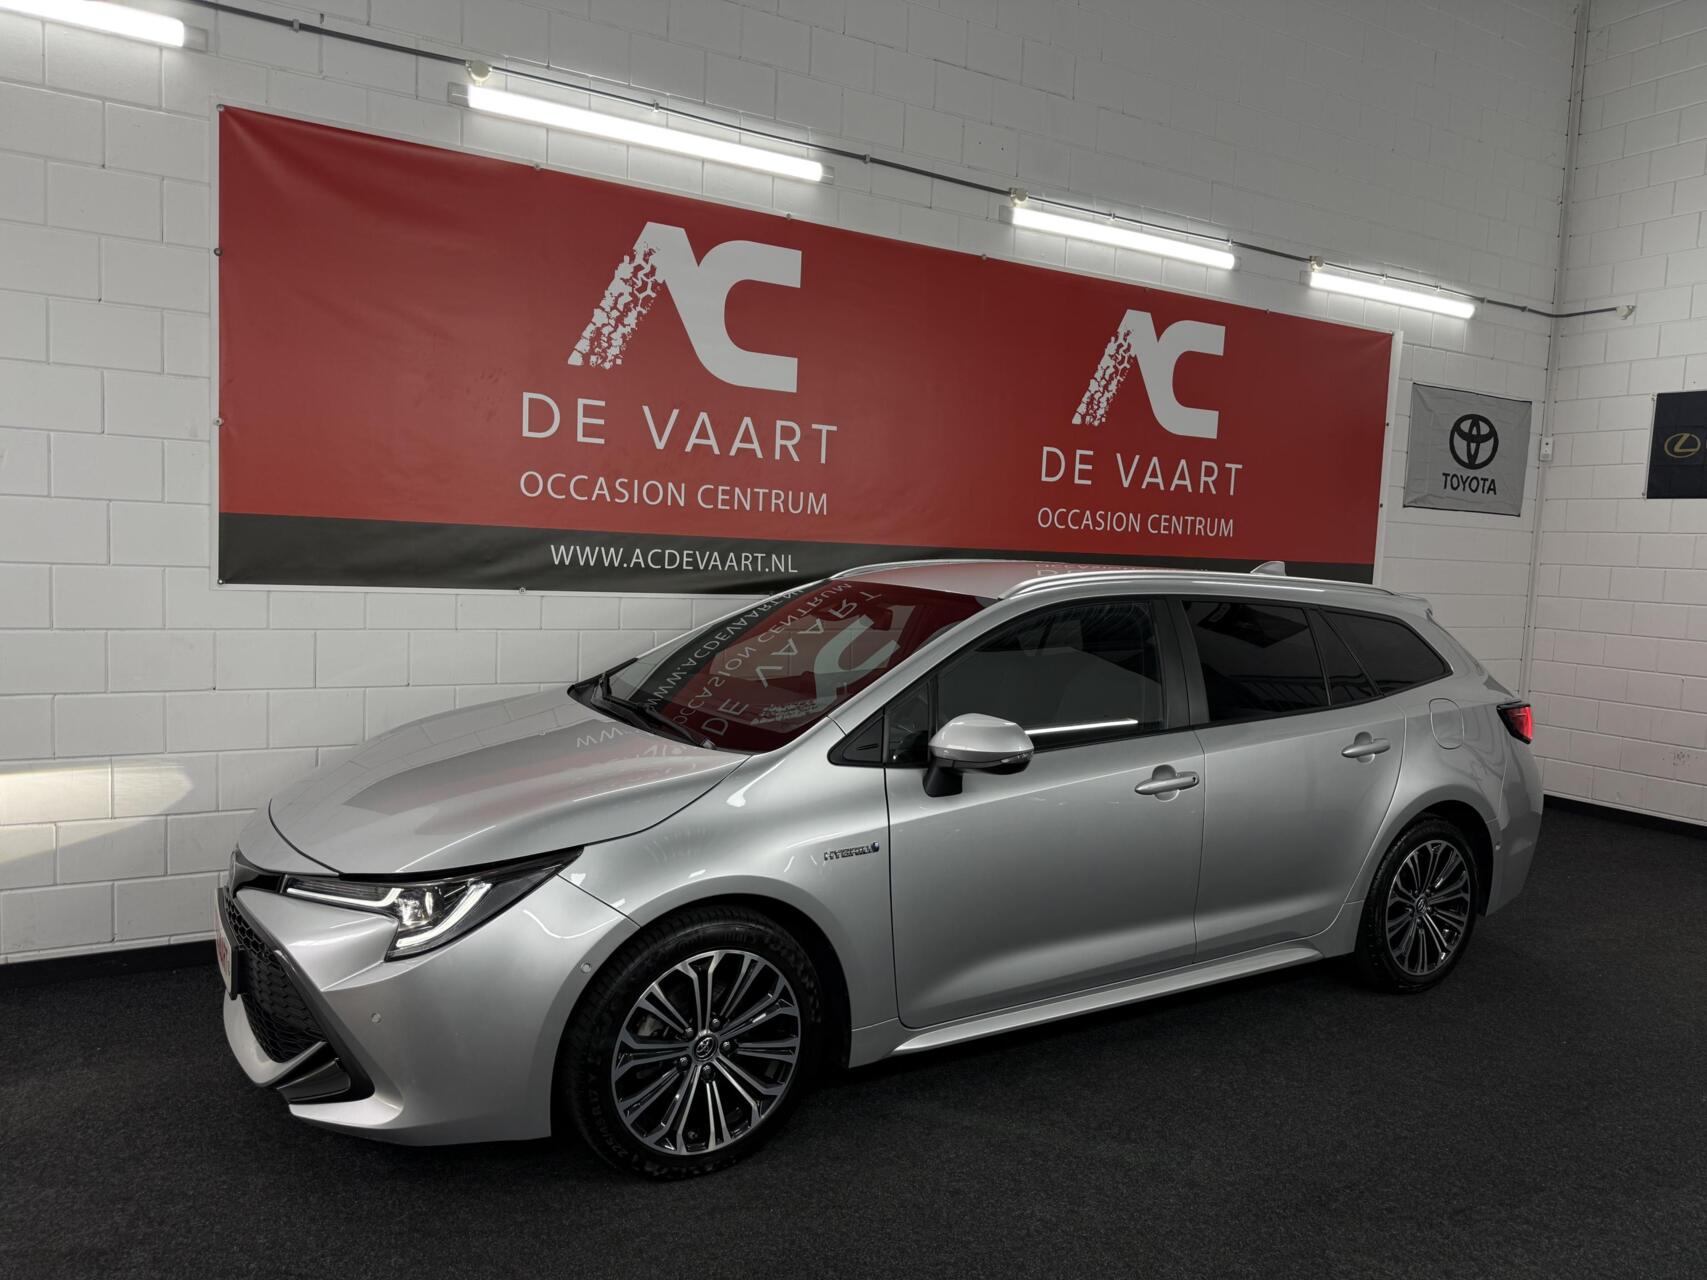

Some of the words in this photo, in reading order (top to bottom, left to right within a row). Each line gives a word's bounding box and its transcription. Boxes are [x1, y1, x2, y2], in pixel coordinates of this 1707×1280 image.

[568, 221, 802, 392] AC
[1072, 309, 1226, 439] AC
[522, 391, 606, 444] DE
[642, 405, 838, 464] VAART
[520, 471, 686, 507] OCCASION
[697, 484, 828, 515] CENTRUM
[1041, 446, 1094, 485] DE
[1116, 453, 1243, 496] VAART
[1442, 472, 1497, 495] TOYOTA
[1037, 507, 1141, 533] OCCASION
[1147, 513, 1234, 537] CENTRUM
[550, 544, 798, 573] WWW.ACDEVAART.NL
